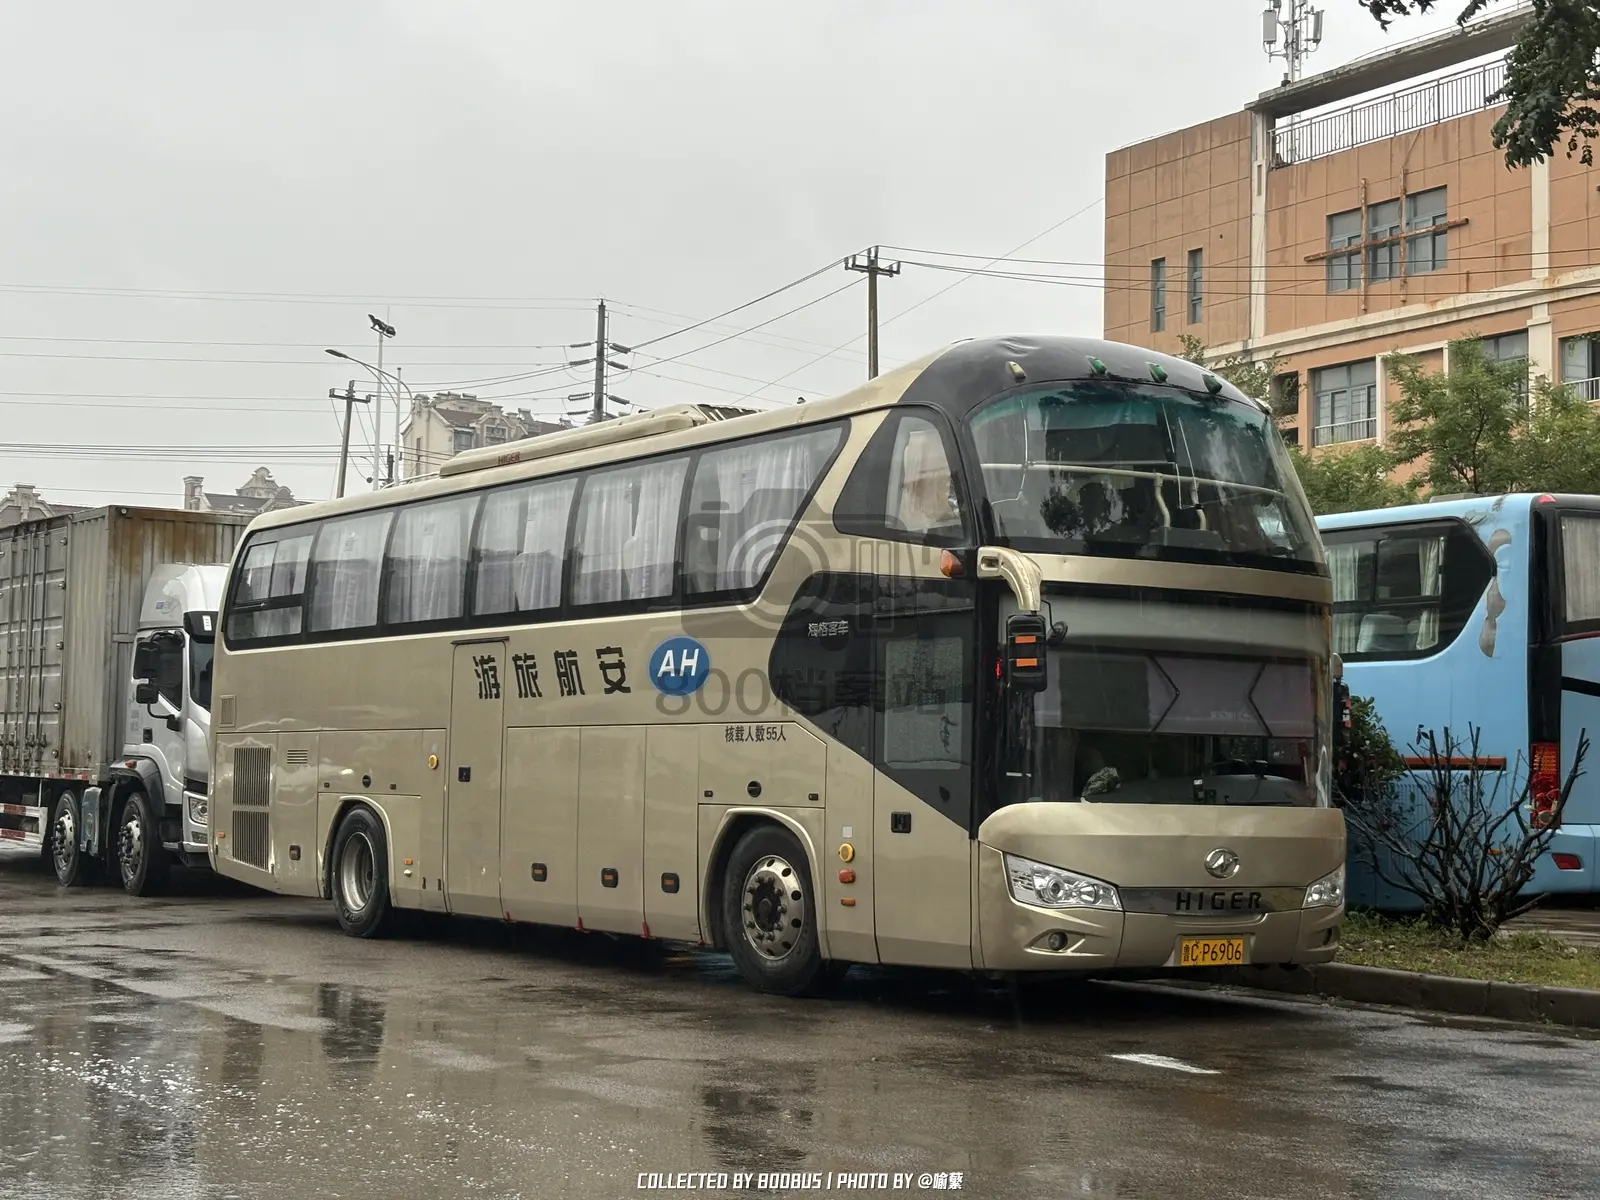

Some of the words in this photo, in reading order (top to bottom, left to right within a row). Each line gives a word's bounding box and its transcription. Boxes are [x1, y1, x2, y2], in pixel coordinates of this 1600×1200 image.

[807, 619, 849, 638] 海格客车
[657, 648, 700, 679] AH
[725, 725, 787, 743] 核载人数55人
[1176, 891, 1263, 911] HIGER
